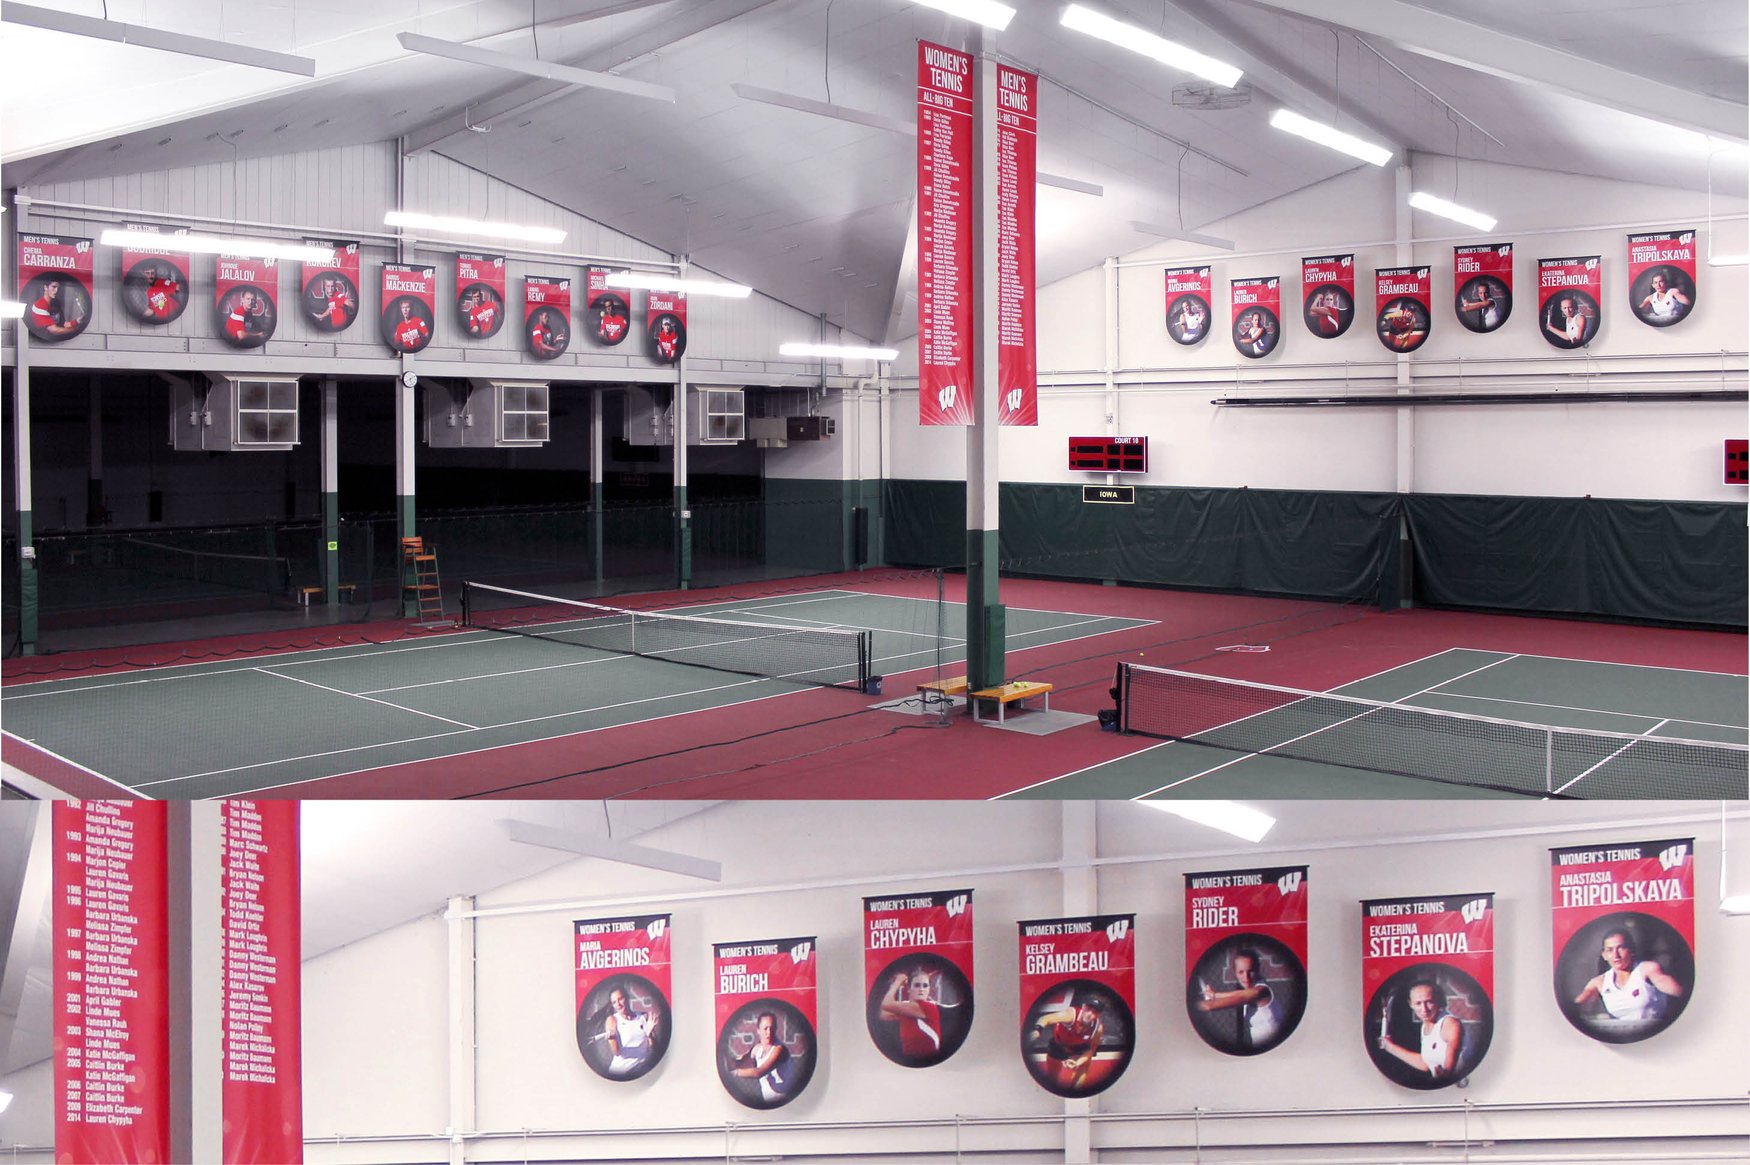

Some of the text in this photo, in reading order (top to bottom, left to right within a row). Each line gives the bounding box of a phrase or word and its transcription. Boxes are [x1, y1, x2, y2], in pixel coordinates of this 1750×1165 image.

[924, 46, 968, 75] WOMEN'S
[930, 67, 963, 93] TENNIS
[1001, 70, 1027, 93] MEN'S
[944, 96, 954, 108] TEN
[999, 88, 1028, 112] TENNIS
[1011, 115, 1020, 126] TEN
[23, 235, 59, 245] MEN'S TENNIS
[1654, 234, 1671, 242] TENNIS
[1632, 245, 1657, 253] ANASTASIA
[1632, 249, 1690, 263] TRIPOLSKAYA
[23, 254, 76, 269] CARRANZA
[1457, 262, 1480, 273] RIDER
[1541, 260, 1562, 268] WOMEN'S
[220, 269, 255, 281] JALALOV
[459, 268, 479, 279] PITRA
[1305, 272, 1337, 283] CHYPYHA
[1541, 274, 1589, 287] STEPANOVA
[385, 280, 426, 293] MACKENZIE
[1167, 282, 1201, 293] AVGERINOS
[1379, 283, 1419, 295] GRAMBEAU
[527, 292, 545, 302] REMY
[1234, 294, 1258, 304] BURICH
[650, 301, 673, 311] ZORDANI
[938, 385, 957, 412] W
[1007, 388, 1022, 413] W
[66, 831, 133, 851] 1993 Amanda Gregory
[229, 859, 244, 869] Jack
[1559, 848, 1641, 866] WOMEN'S TENNIS
[1659, 844, 1688, 872] W
[1192, 874, 1262, 890] WOMEN'S TENNIS
[1277, 871, 1302, 896] W
[1559, 871, 1612, 887] ANASTASIA
[1560, 878, 1683, 908] TRIPOLSKAYA
[870, 897, 932, 913] WOMEN'S TENNIS
[946, 894, 968, 918] W
[1192, 896, 1225, 909] SYDNEY
[1369, 901, 1445, 917] WOMEN'S TENNIS
[229, 909, 244, 919] Todd
[1192, 907, 1239, 929] RIDER
[1461, 899, 1487, 924] W
[229, 919, 247, 929] David
[579, 921, 636, 935] WOMEN'S TENNIS
[647, 918, 666, 941] W
[870, 918, 899, 930] LAUREN
[1025, 922, 1092, 937] WOMEN'S TENNIS
[1106, 919, 1129, 943] W
[1369, 923, 1417, 937] EKATERINA
[66, 928, 138, 945] 1997 Barbara Urbanska
[870, 926, 937, 949] CHYPYHA
[86, 941, 109, 953] Melissa
[580, 941, 601, 951] MARIA
[719, 944, 778, 959] WOMEN'S TENNIS
[1025, 943, 1055, 955] KELSEY
[1369, 932, 1468, 958] STEPANOVA
[86, 952, 107, 963] Andrea
[108, 954, 129, 965] Nathan
[580, 947, 650, 969] AVGERINOS
[790, 942, 812, 965] W
[720, 964, 747, 975] LAUREN
[1025, 951, 1109, 975] GRAMBEAU
[720, 973, 769, 994] BURICH
[86, 995, 100, 1007] April
[100, 996, 121, 1007] Gabler
[86, 1017, 111, 1028] Vanessa
[86, 1027, 104, 1038] Shana
[105, 1029, 129, 1041] McElroy
[67, 1047, 81, 1057] 2004
[86, 1049, 101, 1059] Katie
[86, 1060, 105, 1070] Caitlin
[106, 1061, 125, 1071] Burke
[86, 1103, 113, 1114] Elizabeth
[114, 1104, 143, 1116] Carpenter
[67, 1112, 133, 1126] 2014 Lauren Chypyha
